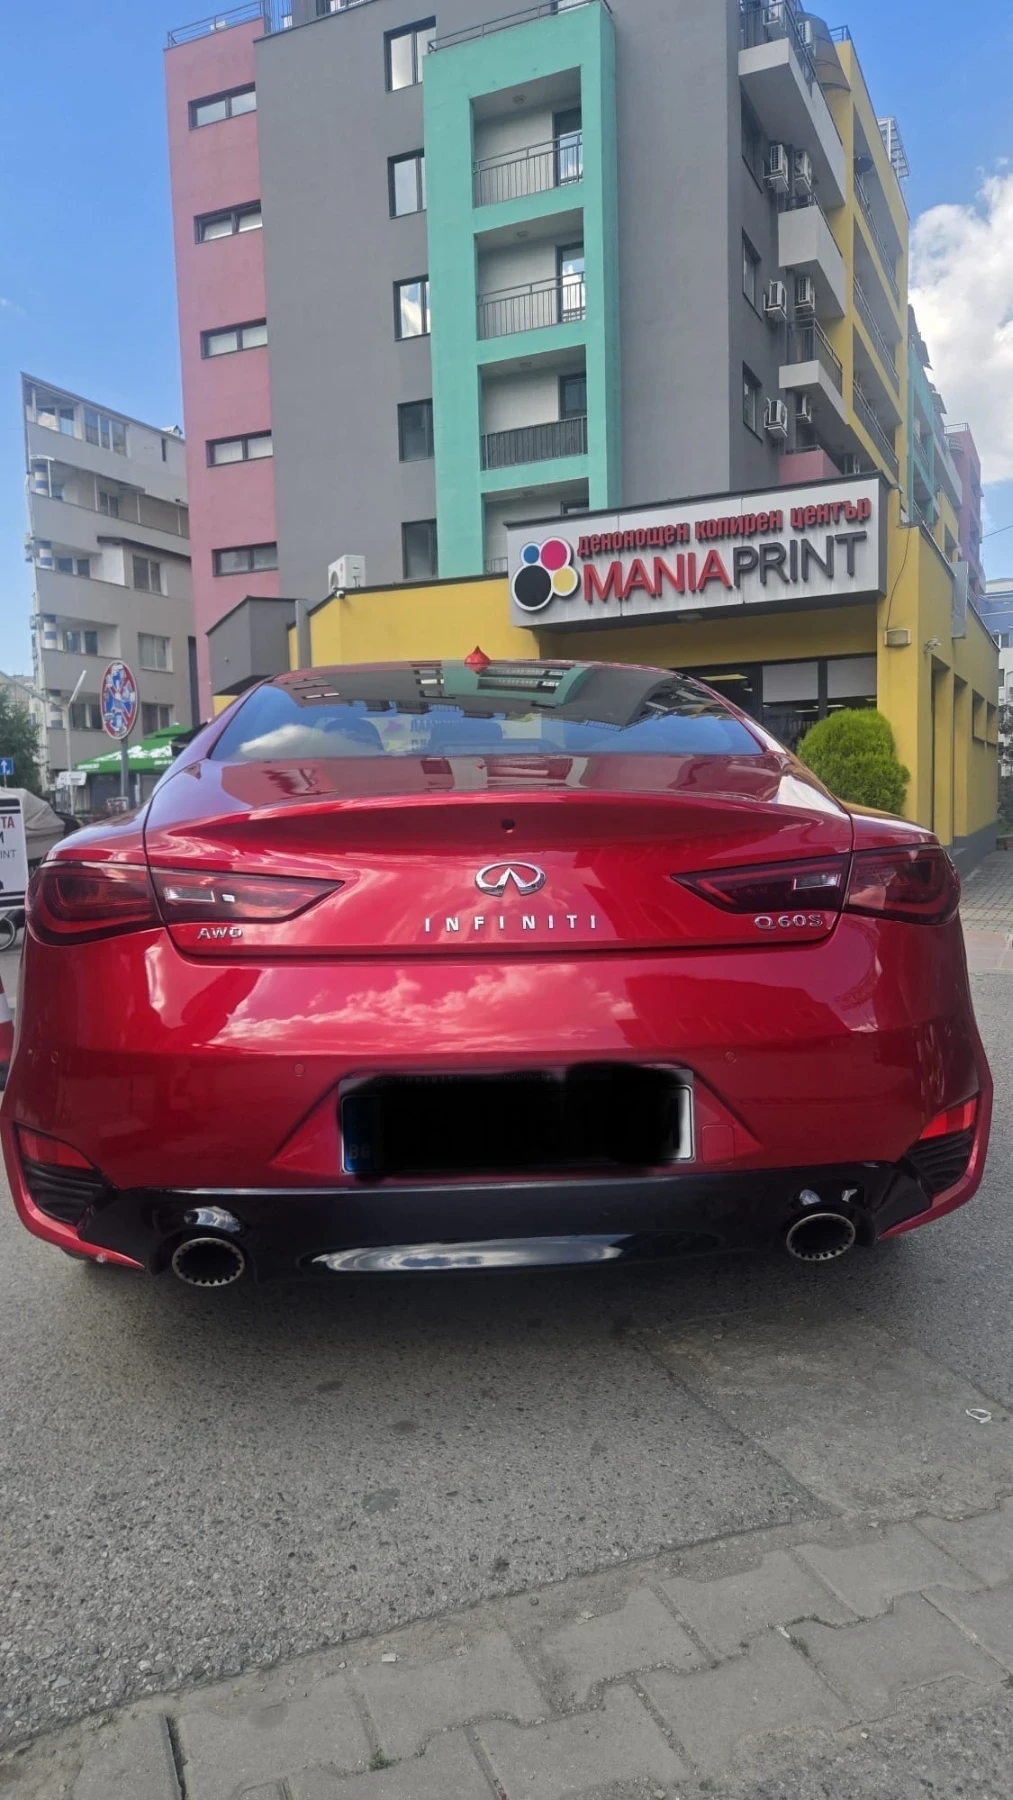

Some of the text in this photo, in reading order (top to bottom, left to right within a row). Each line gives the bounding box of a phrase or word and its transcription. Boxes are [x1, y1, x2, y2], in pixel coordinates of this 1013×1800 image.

[577, 498, 871, 557] денонощен копирен център
[425, 915, 596, 932] INFINITI
